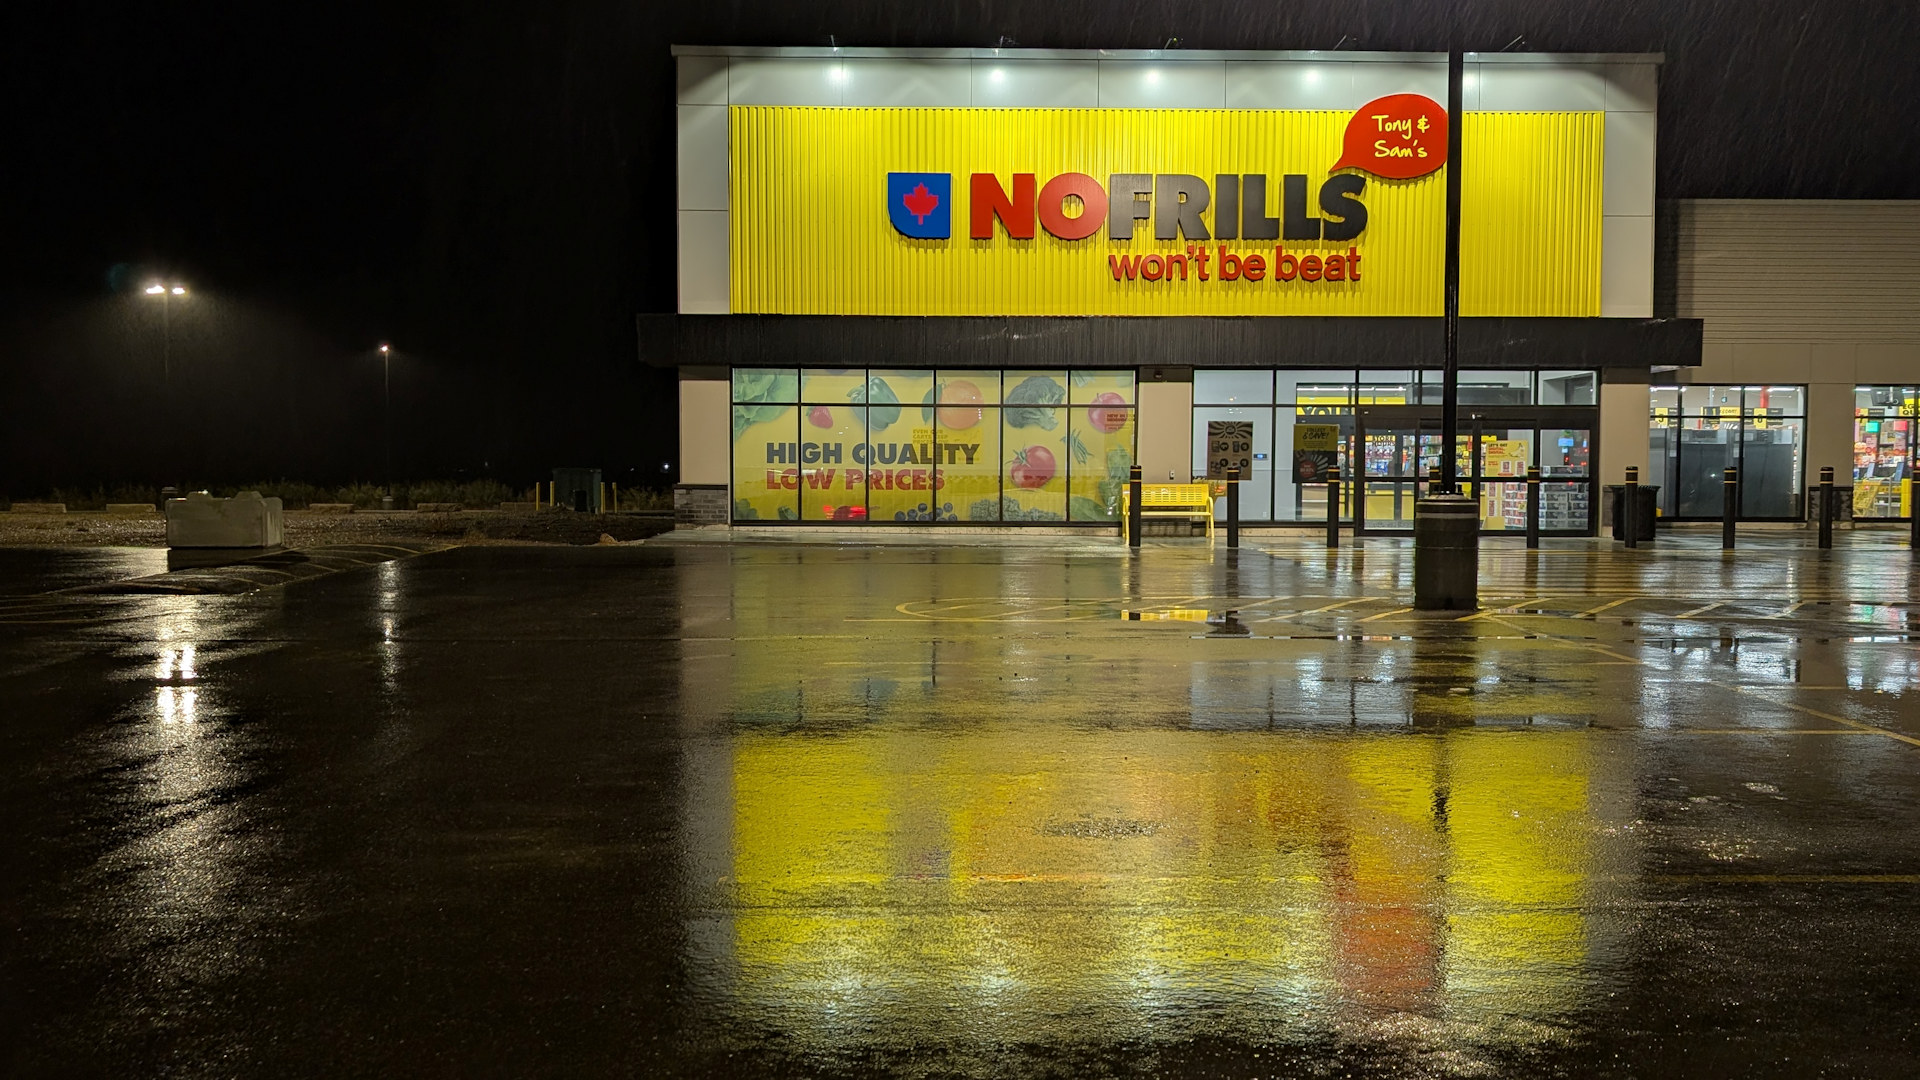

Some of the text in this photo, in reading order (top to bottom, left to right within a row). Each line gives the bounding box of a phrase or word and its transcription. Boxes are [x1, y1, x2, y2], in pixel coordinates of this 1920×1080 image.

[1371, 114, 1430, 140] Tony &
[1374, 139, 1428, 158] Sam's
[1108, 245, 1361, 281] won't be beat
[766, 442, 980, 465] HIGH QUALITY
[766, 468, 945, 490] LOW PRICES
